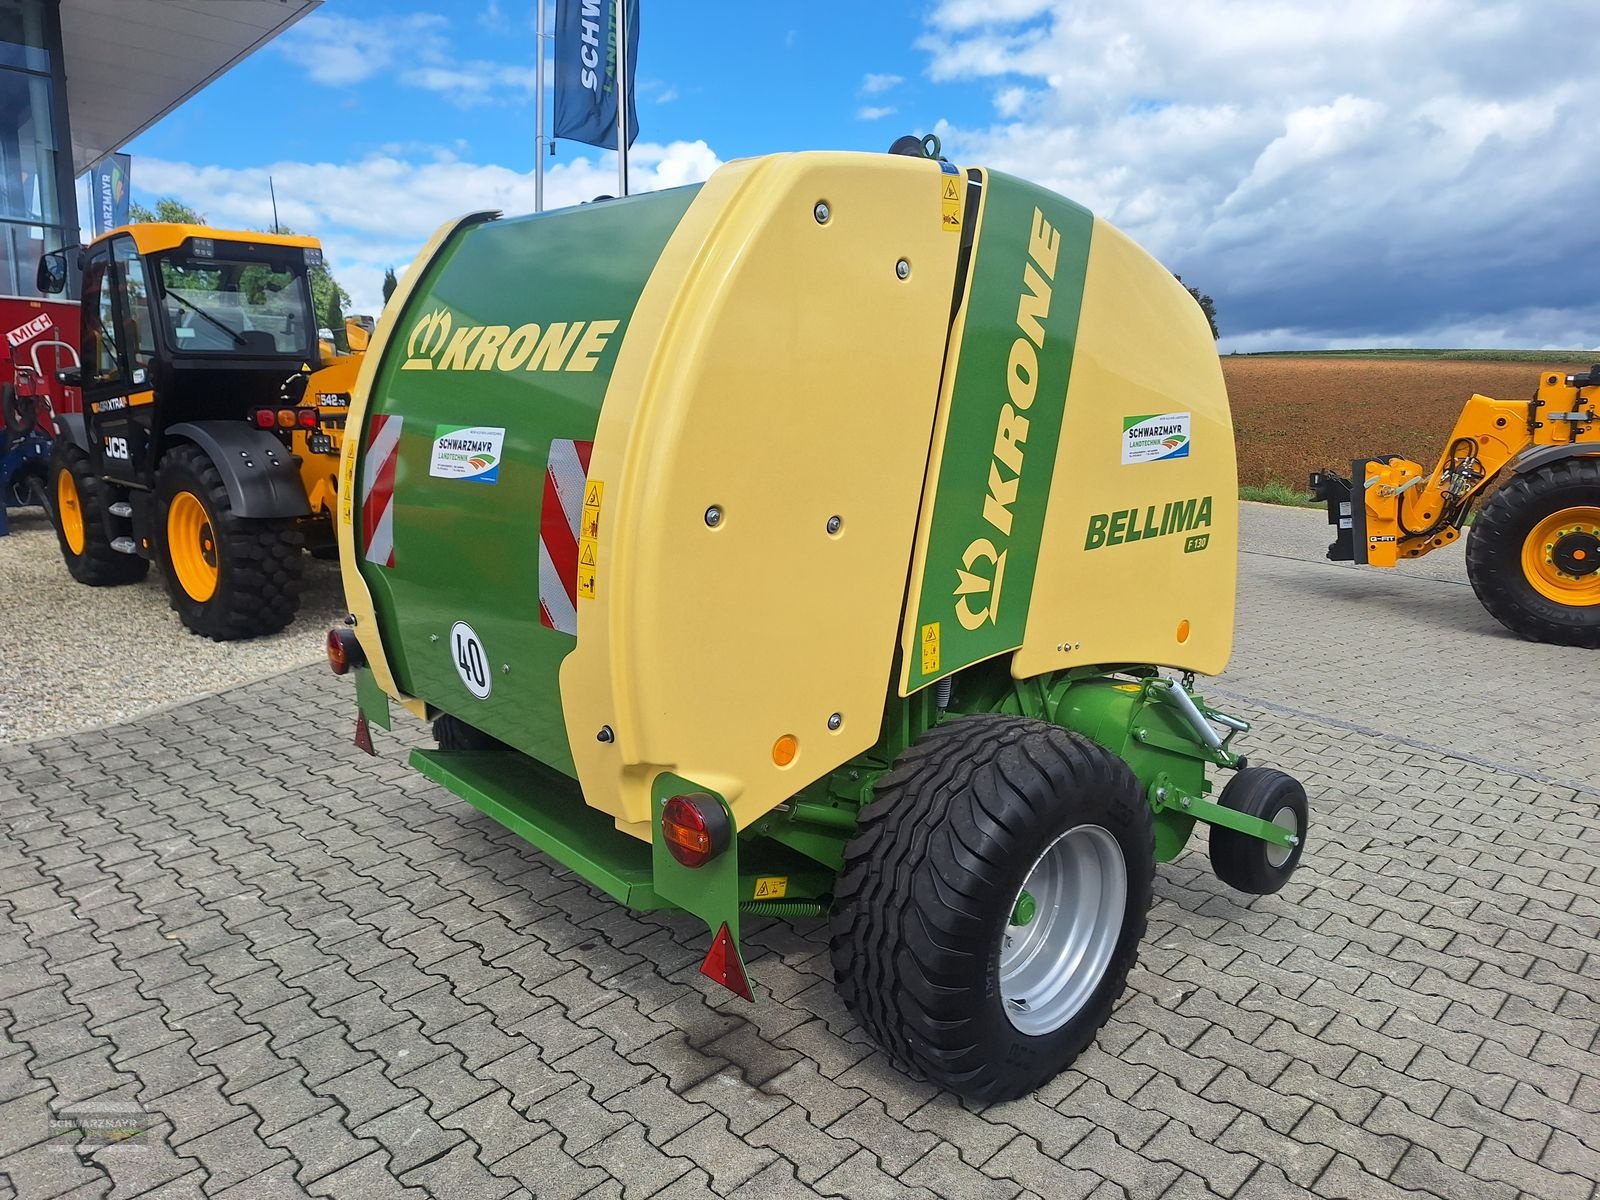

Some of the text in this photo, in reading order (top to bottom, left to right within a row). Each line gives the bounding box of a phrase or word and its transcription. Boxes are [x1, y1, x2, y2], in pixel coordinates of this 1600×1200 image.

[11, 314, 51, 344] MICH
[436, 319, 621, 372] KRONE
[982, 206, 1061, 537] KRONE
[1129, 424, 1182, 439] SCHWARZMAYR
[105, 436, 128, 459] JCB
[438, 438, 492, 452] SCHWARZMAYR
[1129, 439, 1161, 448] LANDTECHNIK
[438, 452, 468, 461] LANDTECHNIK
[1084, 496, 1212, 551] BELLIMA
[1194, 537, 1206, 548] 130
[457, 633, 485, 687] 40
